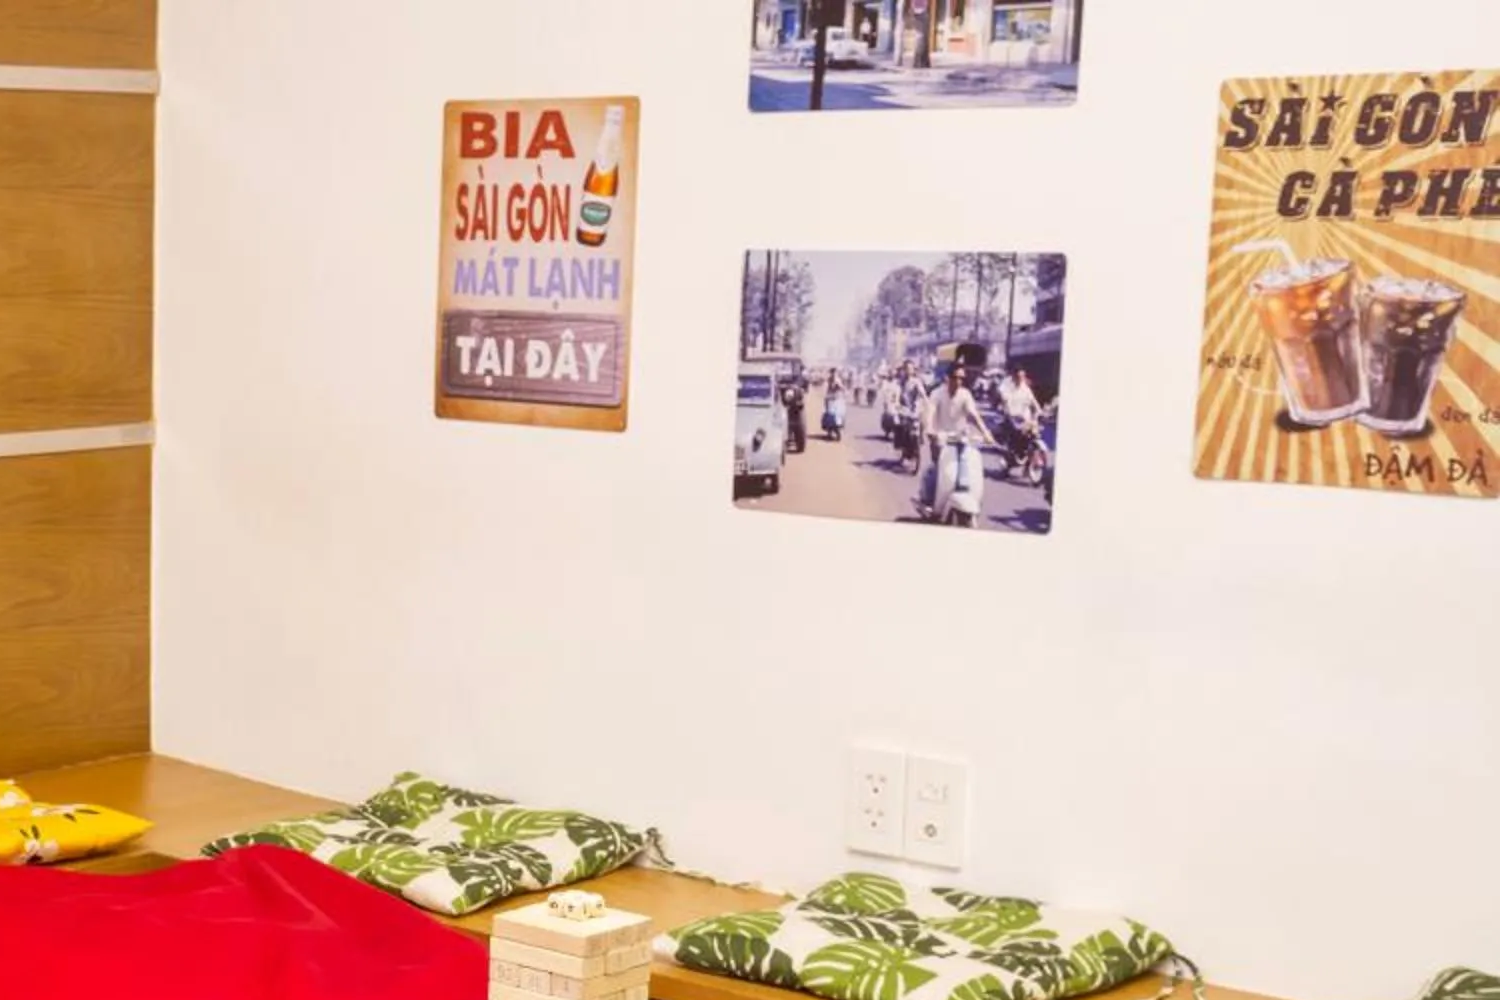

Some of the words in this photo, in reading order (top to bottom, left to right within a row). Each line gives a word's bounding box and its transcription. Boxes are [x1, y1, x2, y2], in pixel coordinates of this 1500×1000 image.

[459, 109, 576, 159] BIA
[1354, 75, 1500, 146] GÒN
[454, 164, 498, 242] SÀI
[506, 164, 571, 243] GÒN
[1276, 156, 1358, 218] CÀ
[453, 247, 520, 297] MÁT
[528, 257, 621, 311] LẠNH
[455, 336, 514, 387] TẠI
[525, 328, 608, 383] ĐÂY
[1364, 443, 1435, 487] ĐẬM
